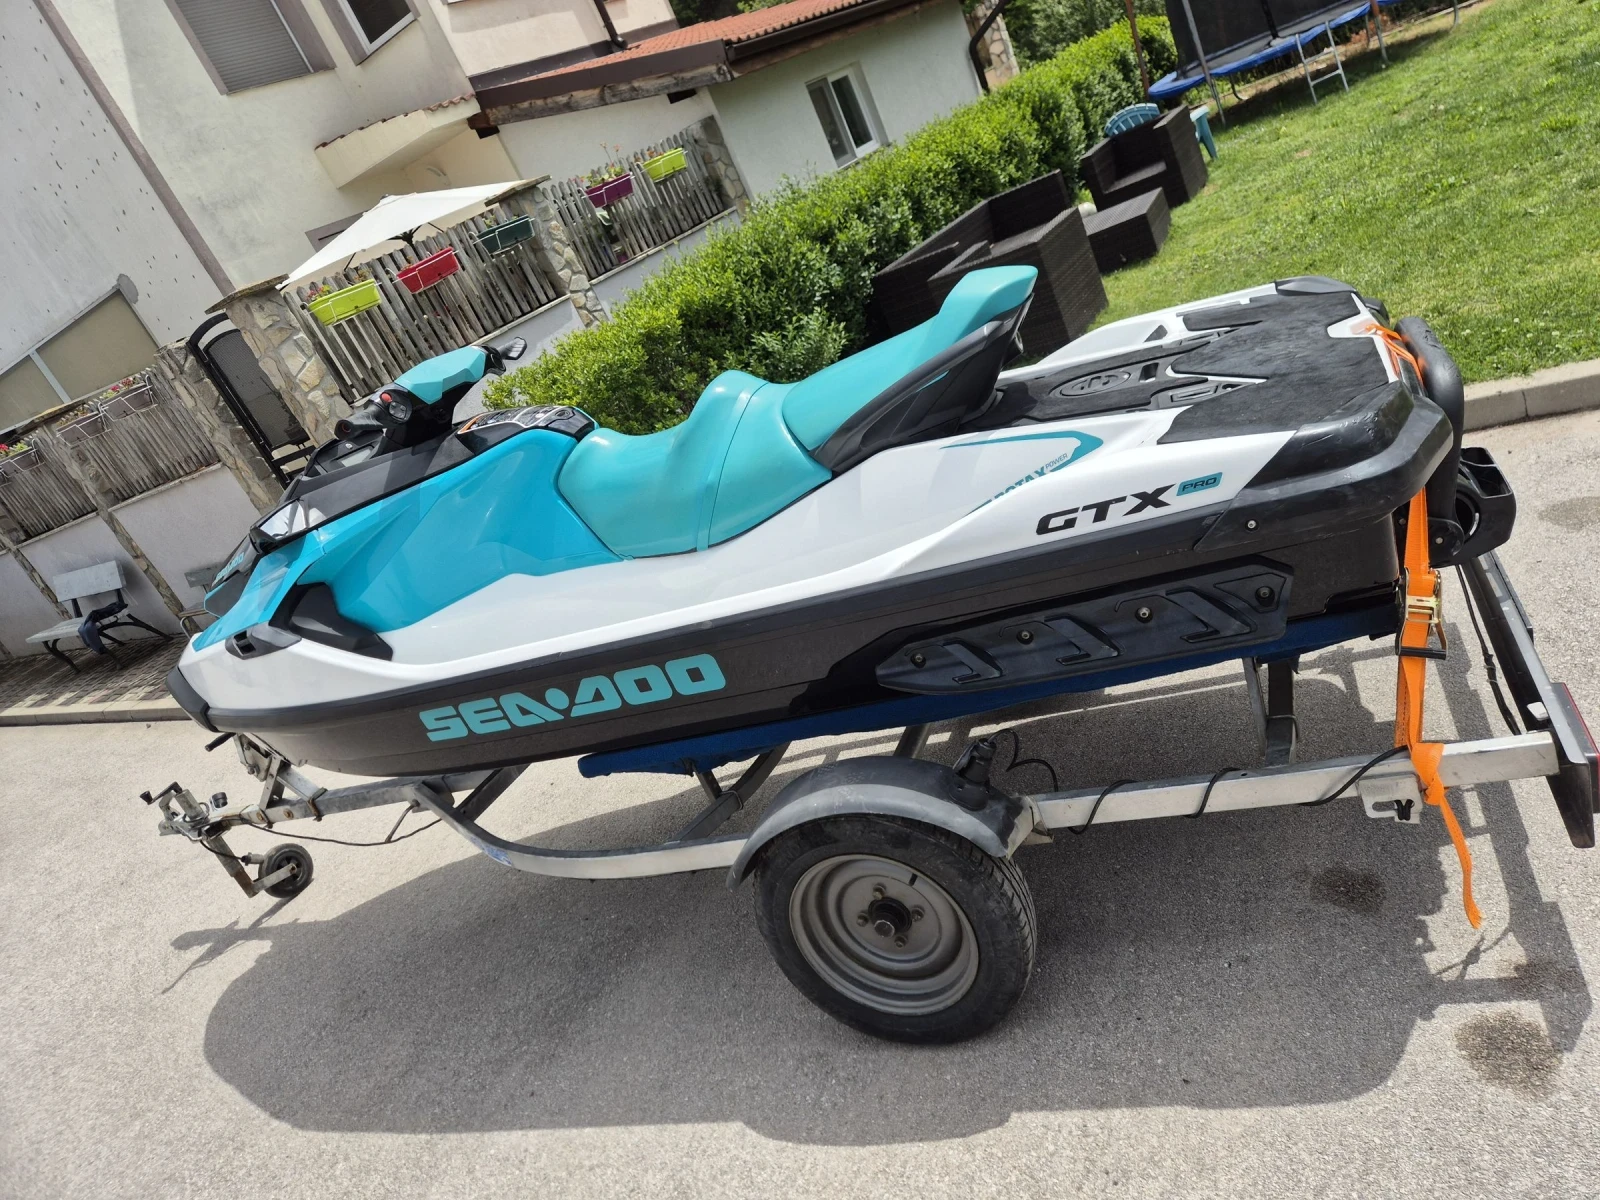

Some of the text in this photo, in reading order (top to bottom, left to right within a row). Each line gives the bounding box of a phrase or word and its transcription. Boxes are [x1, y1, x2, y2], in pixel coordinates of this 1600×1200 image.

[1045, 453, 1068, 469] POWER
[1036, 475, 1218, 535] GTX PRO
